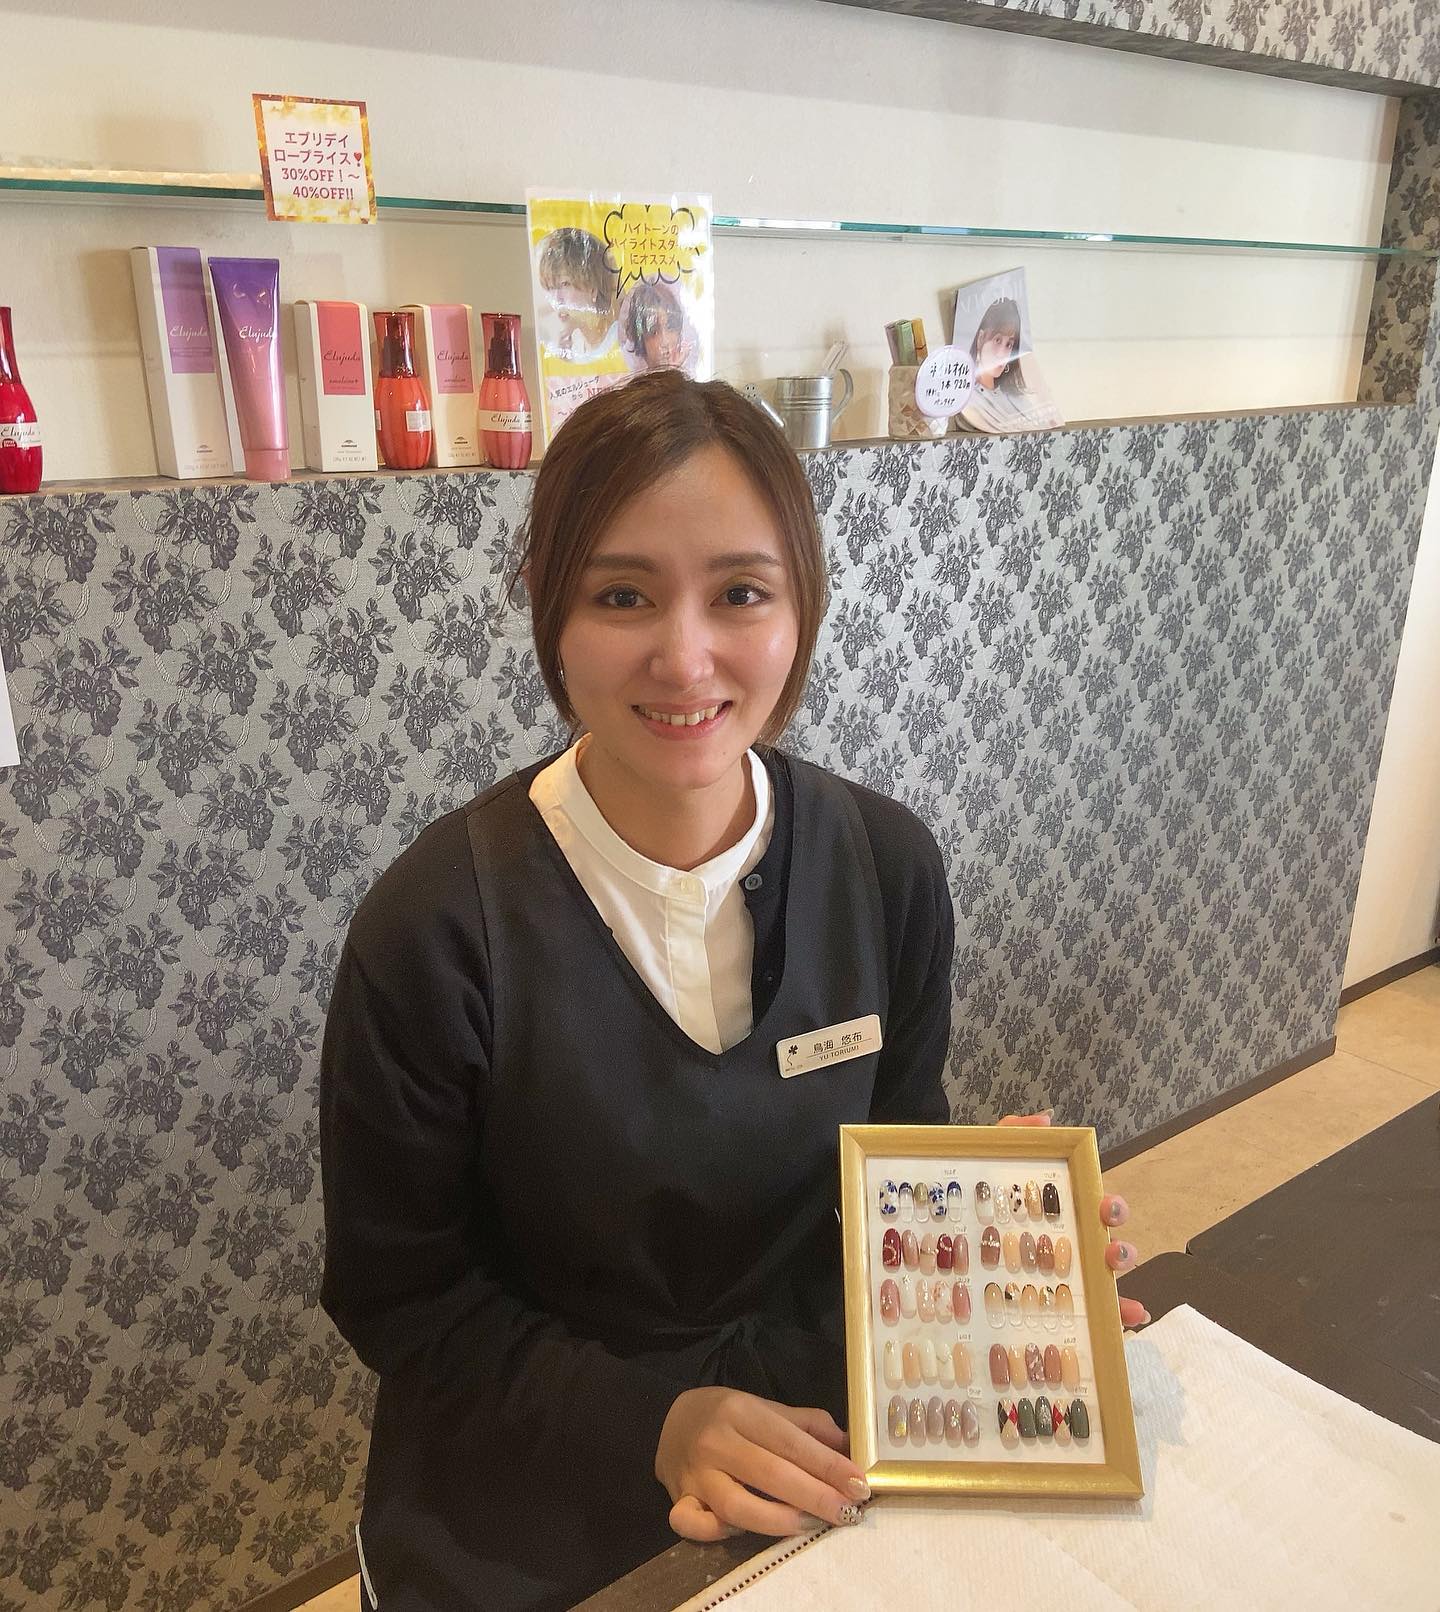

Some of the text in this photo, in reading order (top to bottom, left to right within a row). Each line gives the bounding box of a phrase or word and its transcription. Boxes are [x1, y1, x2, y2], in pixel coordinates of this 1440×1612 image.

[292, 186, 354, 200] 40%OFF!!
[624, 223, 679, 236] ハイトーンの
[630, 253, 677, 266] にオススメ
[323, 350, 361, 365] Elujuda
[437, 350, 469, 365] Elujuda
[831, 1045, 859, 1058] TORIUMI
